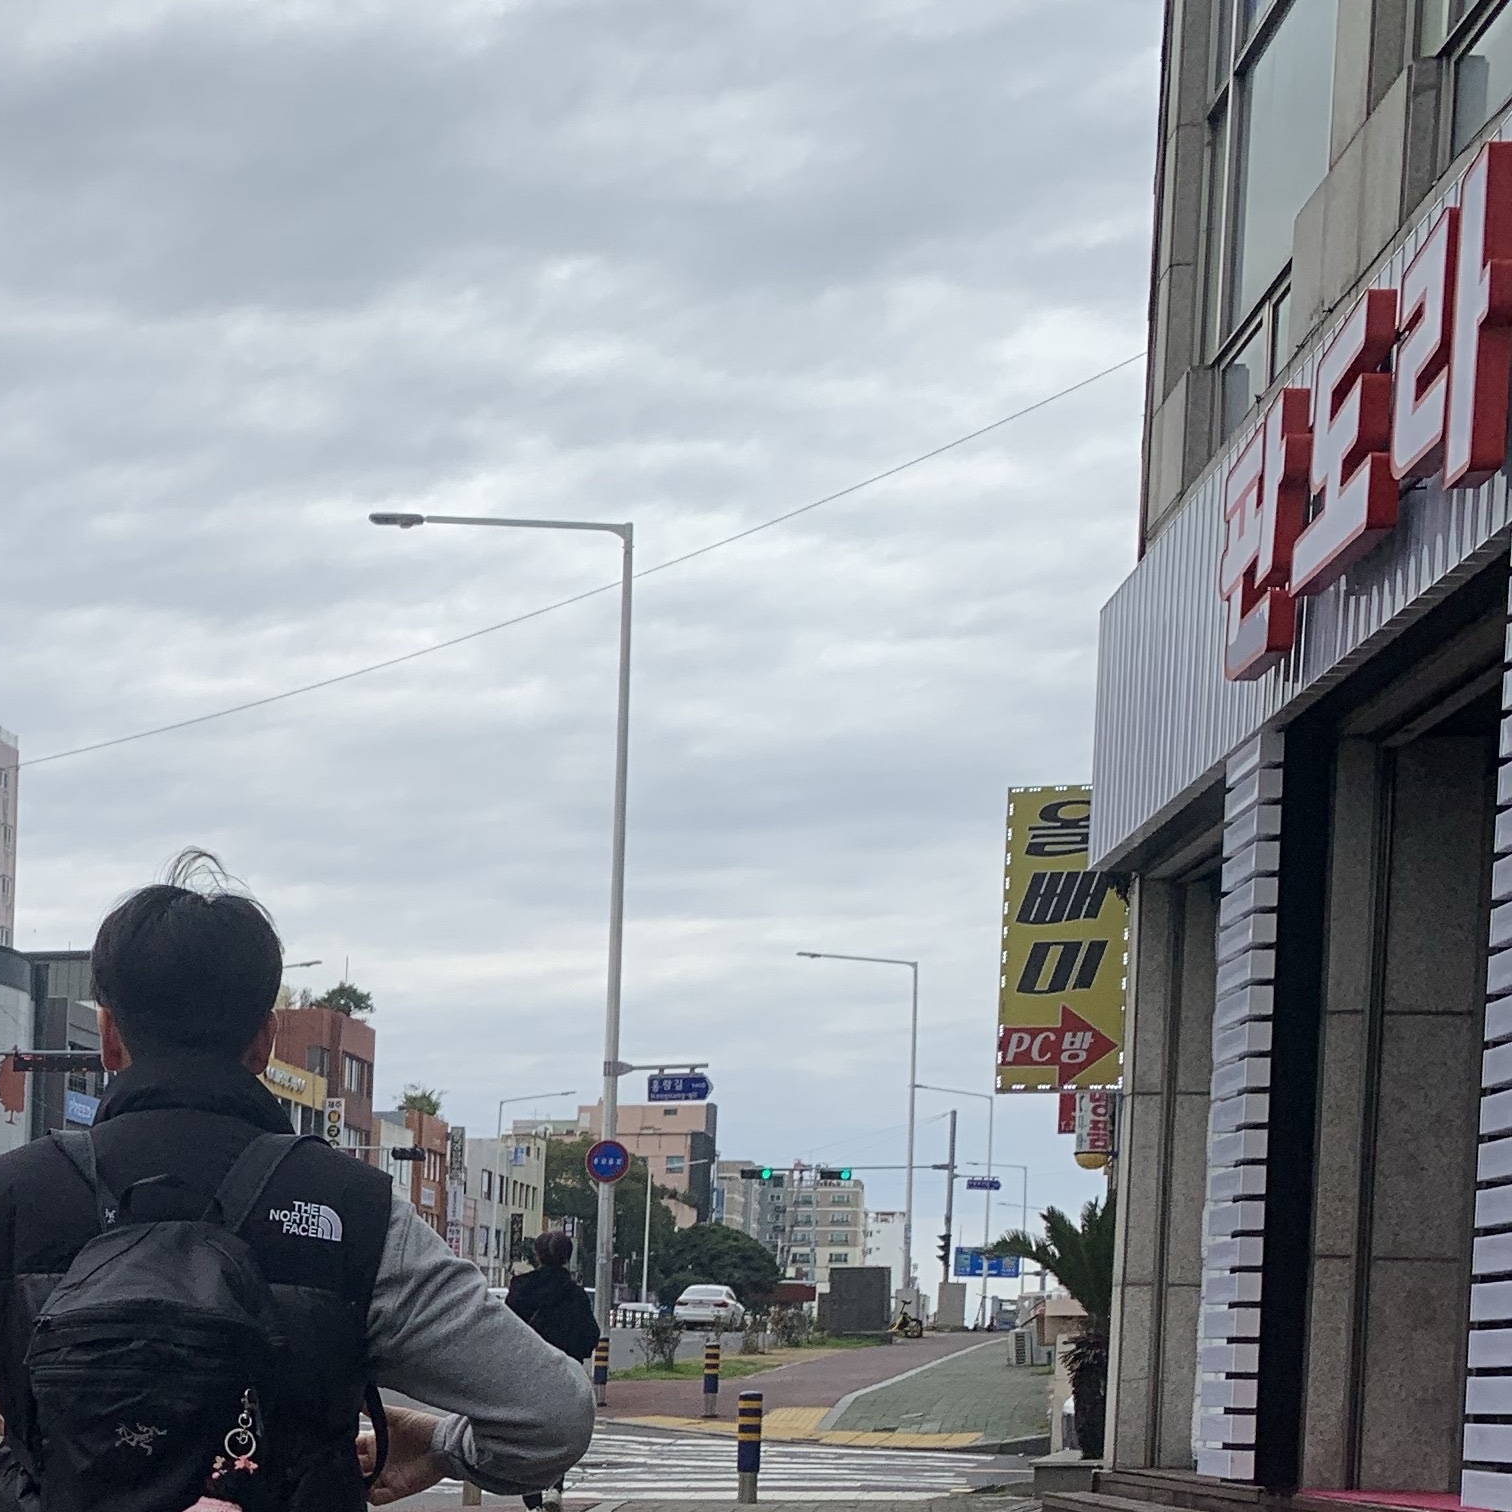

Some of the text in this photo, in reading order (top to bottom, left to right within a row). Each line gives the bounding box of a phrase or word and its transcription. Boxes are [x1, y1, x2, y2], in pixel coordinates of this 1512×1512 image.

[1221, 141, 1512, 681] 판도라
[293, 1201, 320, 1215] THE
[269, 1208, 318, 1226] NORTH
[282, 1221, 317, 1237] FACE
